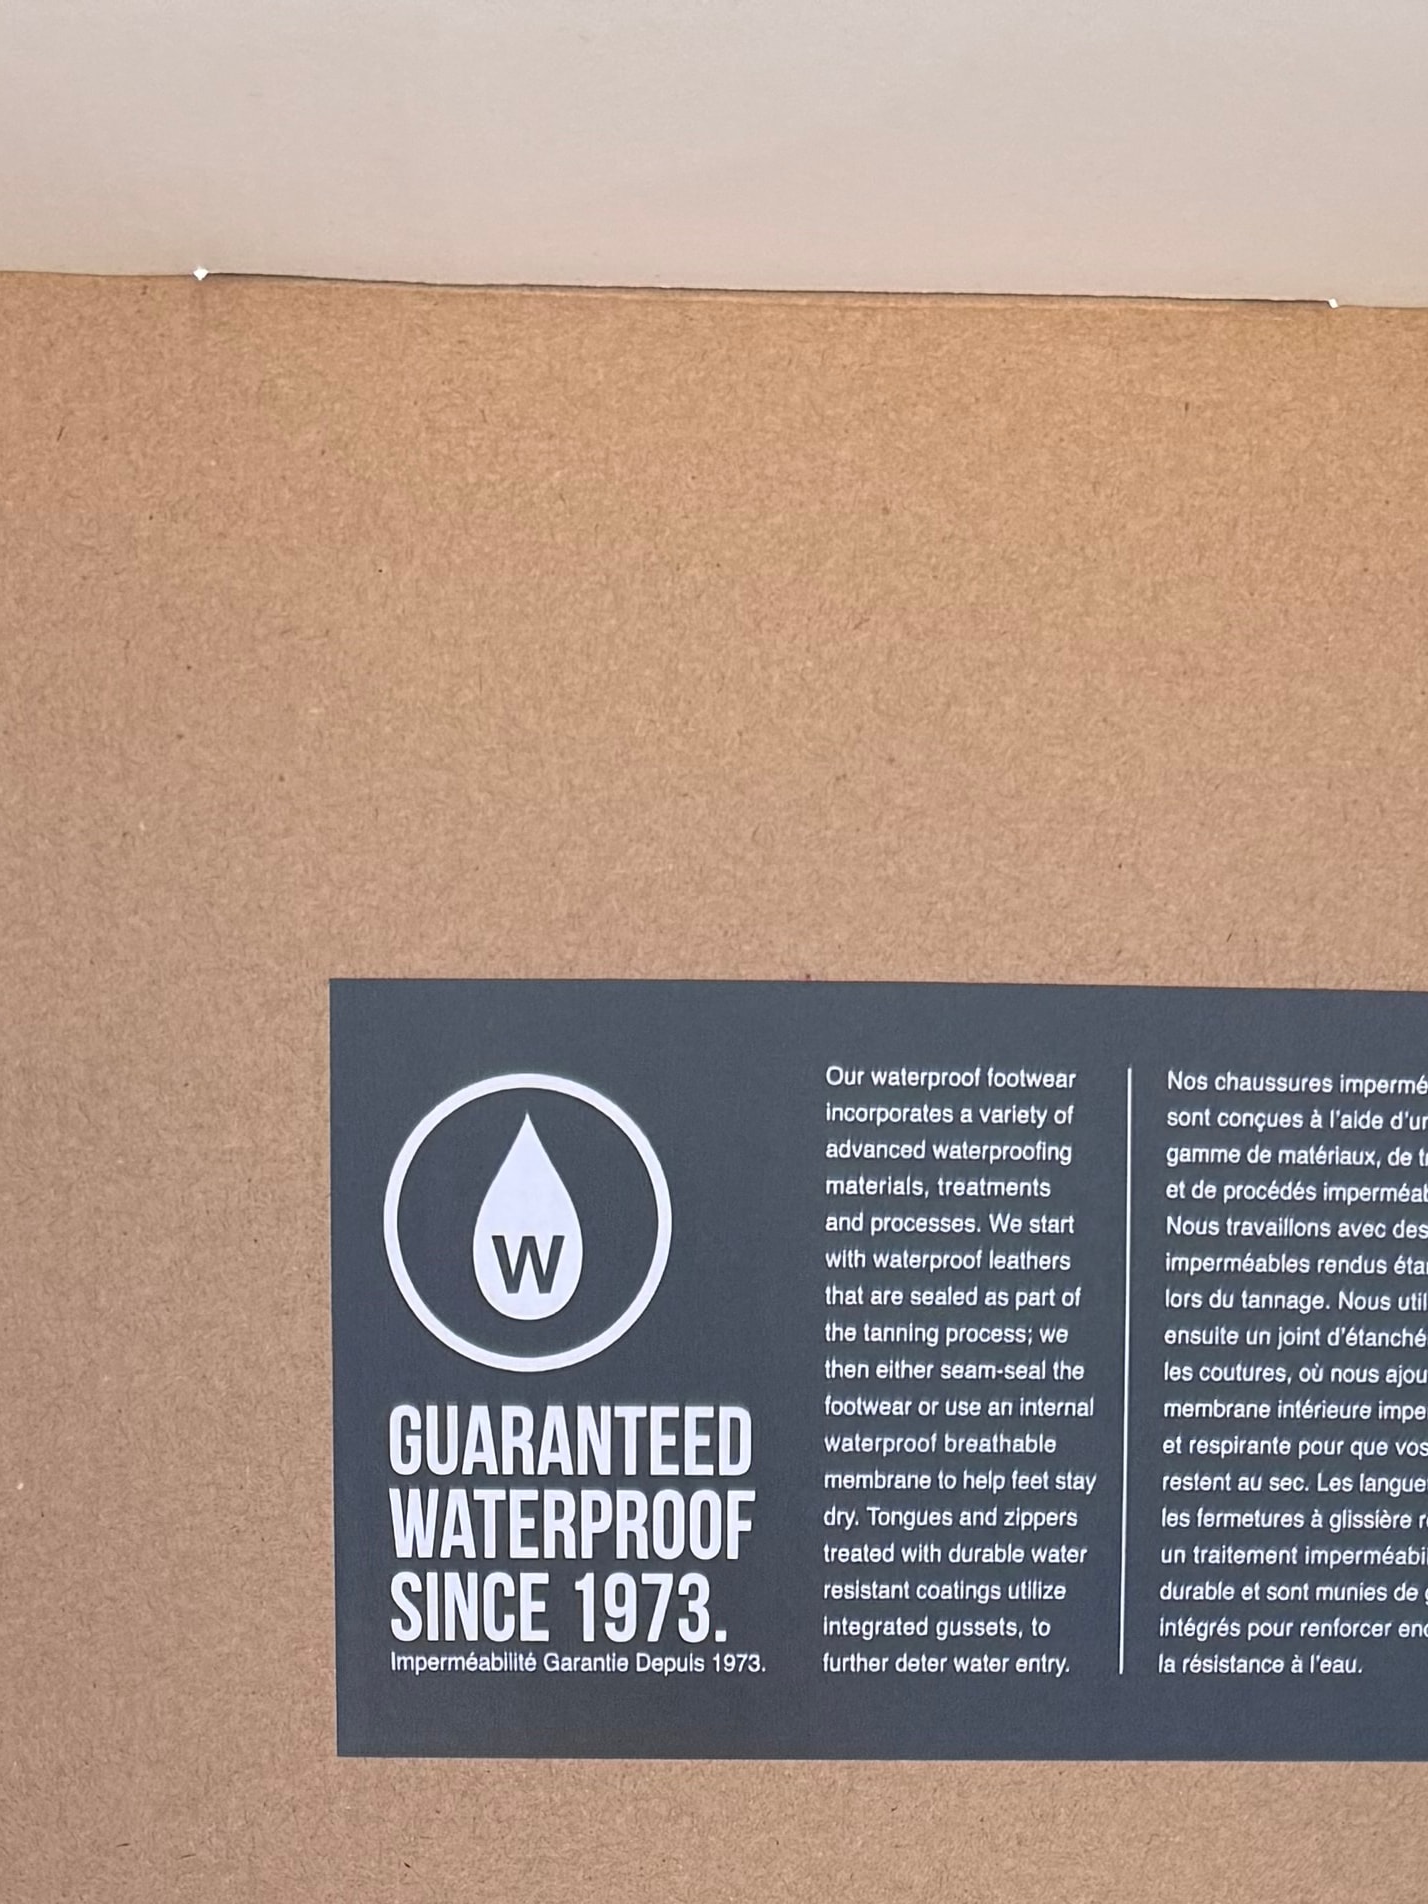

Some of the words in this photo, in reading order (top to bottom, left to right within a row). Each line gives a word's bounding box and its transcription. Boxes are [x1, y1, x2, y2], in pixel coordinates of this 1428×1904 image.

[825, 1065, 865, 1086] Our
[870, 1065, 981, 1091] waterproof
[987, 1066, 1076, 1088] footwear
[1167, 1069, 1208, 1090] Nos
[1214, 1071, 1333, 1092] chaussures
[826, 1102, 953, 1126] incorporates
[979, 1104, 1047, 1128] variety
[1053, 1104, 1074, 1124] of
[1167, 1107, 1210, 1126] sont
[1217, 1111, 1303, 1132] conçues
[825, 1138, 925, 1158] advanced
[932, 1139, 1072, 1165] waterproofing
[1166, 1147, 1241, 1167] gamme
[1246, 1143, 1272, 1164] de
[1278, 1144, 1380, 1167] matériaux,
[1387, 1146, 1412, 1166] de
[825, 1174, 929, 1198] materials,
[937, 1177, 1051, 1197] treatments
[1165, 1179, 1185, 1199] et
[1191, 1179, 1217, 1199] de
[1223, 1179, 1317, 1204] procédés
[825, 1210, 863, 1231] and
[870, 1216, 980, 1237] processes.
[988, 1212, 1022, 1233] We
[1029, 1214, 1074, 1233] start
[1166, 1215, 1220, 1235] Nous
[1226, 1215, 1331, 1236] travaillons
[1337, 1221, 1386, 1238] avec
[492, 1234, 565, 1294] W
[825, 1248, 865, 1268] with
[872, 1248, 982, 1273] waterproof
[989, 1248, 1070, 1270] leathers
[1165, 1251, 1310, 1276] imperméables
[1317, 1254, 1387, 1274] rendus
[825, 1283, 863, 1305] that
[870, 1289, 903, 1305] are
[910, 1285, 977, 1306] sealed
[984, 1290, 1009, 1306] as
[1015, 1287, 1055, 1311] part
[1061, 1286, 1081, 1307] of
[1165, 1288, 1202, 1308] lors
[1208, 1287, 1234, 1308] du
[1241, 1290, 1330, 1314] tannage.
[1338, 1290, 1391, 1310] Nous
[824, 1321, 856, 1342] the
[863, 1322, 939, 1347] tanning
[945, 1326, 1032, 1347] process;
[1039, 1327, 1068, 1343] we
[1164, 1325, 1239, 1345] ensuite
[1276, 1326, 1321, 1350] joint
[824, 1356, 869, 1378] then
[875, 1358, 934, 1379] either
[940, 1358, 1046, 1379] seam-seal
[1052, 1359, 1084, 1380] the
[1164, 1360, 1193, 1381] les
[1199, 1362, 1291, 1384] coutures,
[1298, 1362, 1323, 1382] où
[1330, 1367, 1379, 1383] nous
[824, 1393, 912, 1415] footwear
[917, 1400, 939, 1416] or
[945, 1399, 981, 1416] use
[987, 1400, 1013, 1416] an
[1019, 1395, 1094, 1416] internal
[1163, 1398, 1271, 1418] membrane
[1277, 1398, 1371, 1419] intérieure
[389, 1404, 753, 1476] GUARANTEED
[824, 1431, 937, 1457] waterproof
[944, 1432, 1056, 1453] breathable
[1162, 1435, 1182, 1454] et
[1189, 1435, 1291, 1459] respirante
[1298, 1439, 1344, 1459] pour
[1350, 1440, 1388, 1460] que
[824, 1468, 931, 1489] membrane
[937, 1469, 956, 1489] to
[963, 1469, 1005, 1494] help
[1011, 1469, 1049, 1489] feet
[1055, 1470, 1096, 1495] stay
[1162, 1471, 1231, 1491] restent
[1237, 1475, 1262, 1491] au
[1269, 1476, 1309, 1491] sec.
[1317, 1472, 1353, 1492] Les
[389, 1488, 757, 1560] WATERPROOF
[823, 1504, 858, 1530] dry.
[866, 1506, 952, 1531] Tongues
[959, 1505, 997, 1526] and
[1003, 1506, 1077, 1531] zippers
[1161, 1506, 1190, 1527] les
[1196, 1507, 1304, 1528] fermetures
[1329, 1508, 1412, 1533] glissière
[823, 1541, 894, 1562] treated
[901, 1542, 941, 1563] with
[948, 1542, 1024, 1563] durable
[1031, 1544, 1087, 1563] water
[1193, 1544, 1298, 1564] traitement
[823, 1579, 909, 1599] resistant
[916, 1579, 1001, 1604] coatings
[1008, 1578, 1066, 1599] utilize
[1159, 1580, 1235, 1600] durable
[1240, 1581, 1260, 1600] et
[1266, 1582, 1309, 1601] sont
[1315, 1581, 1387, 1601] munies
[1393, 1581, 1418, 1601] de
[390, 1572, 550, 1644] SINCE
[574, 1572, 728, 1644] 1973.
[823, 1615, 928, 1640] integrated
[936, 1616, 1022, 1641] gussets,
[1031, 1616, 1051, 1636] to
[1159, 1616, 1240, 1641] intégrés
[1247, 1620, 1293, 1641] pour
[1300, 1616, 1392, 1637] renforcer
[390, 1651, 538, 1676] Imperméabilité
[543, 1652, 630, 1673] Garantie
[636, 1653, 706, 1678] Depuis
[712, 1654, 767, 1674] 1973.
[822, 1651, 889, 1672] further
[895, 1652, 947, 1672] deter
[953, 1653, 1009, 1672] water
[1015, 1653, 1069, 1677] entry.
[1158, 1652, 1175, 1673] la
[1182, 1653, 1284, 1673] résistance
[1310, 1653, 1362, 1674] l'eau.
